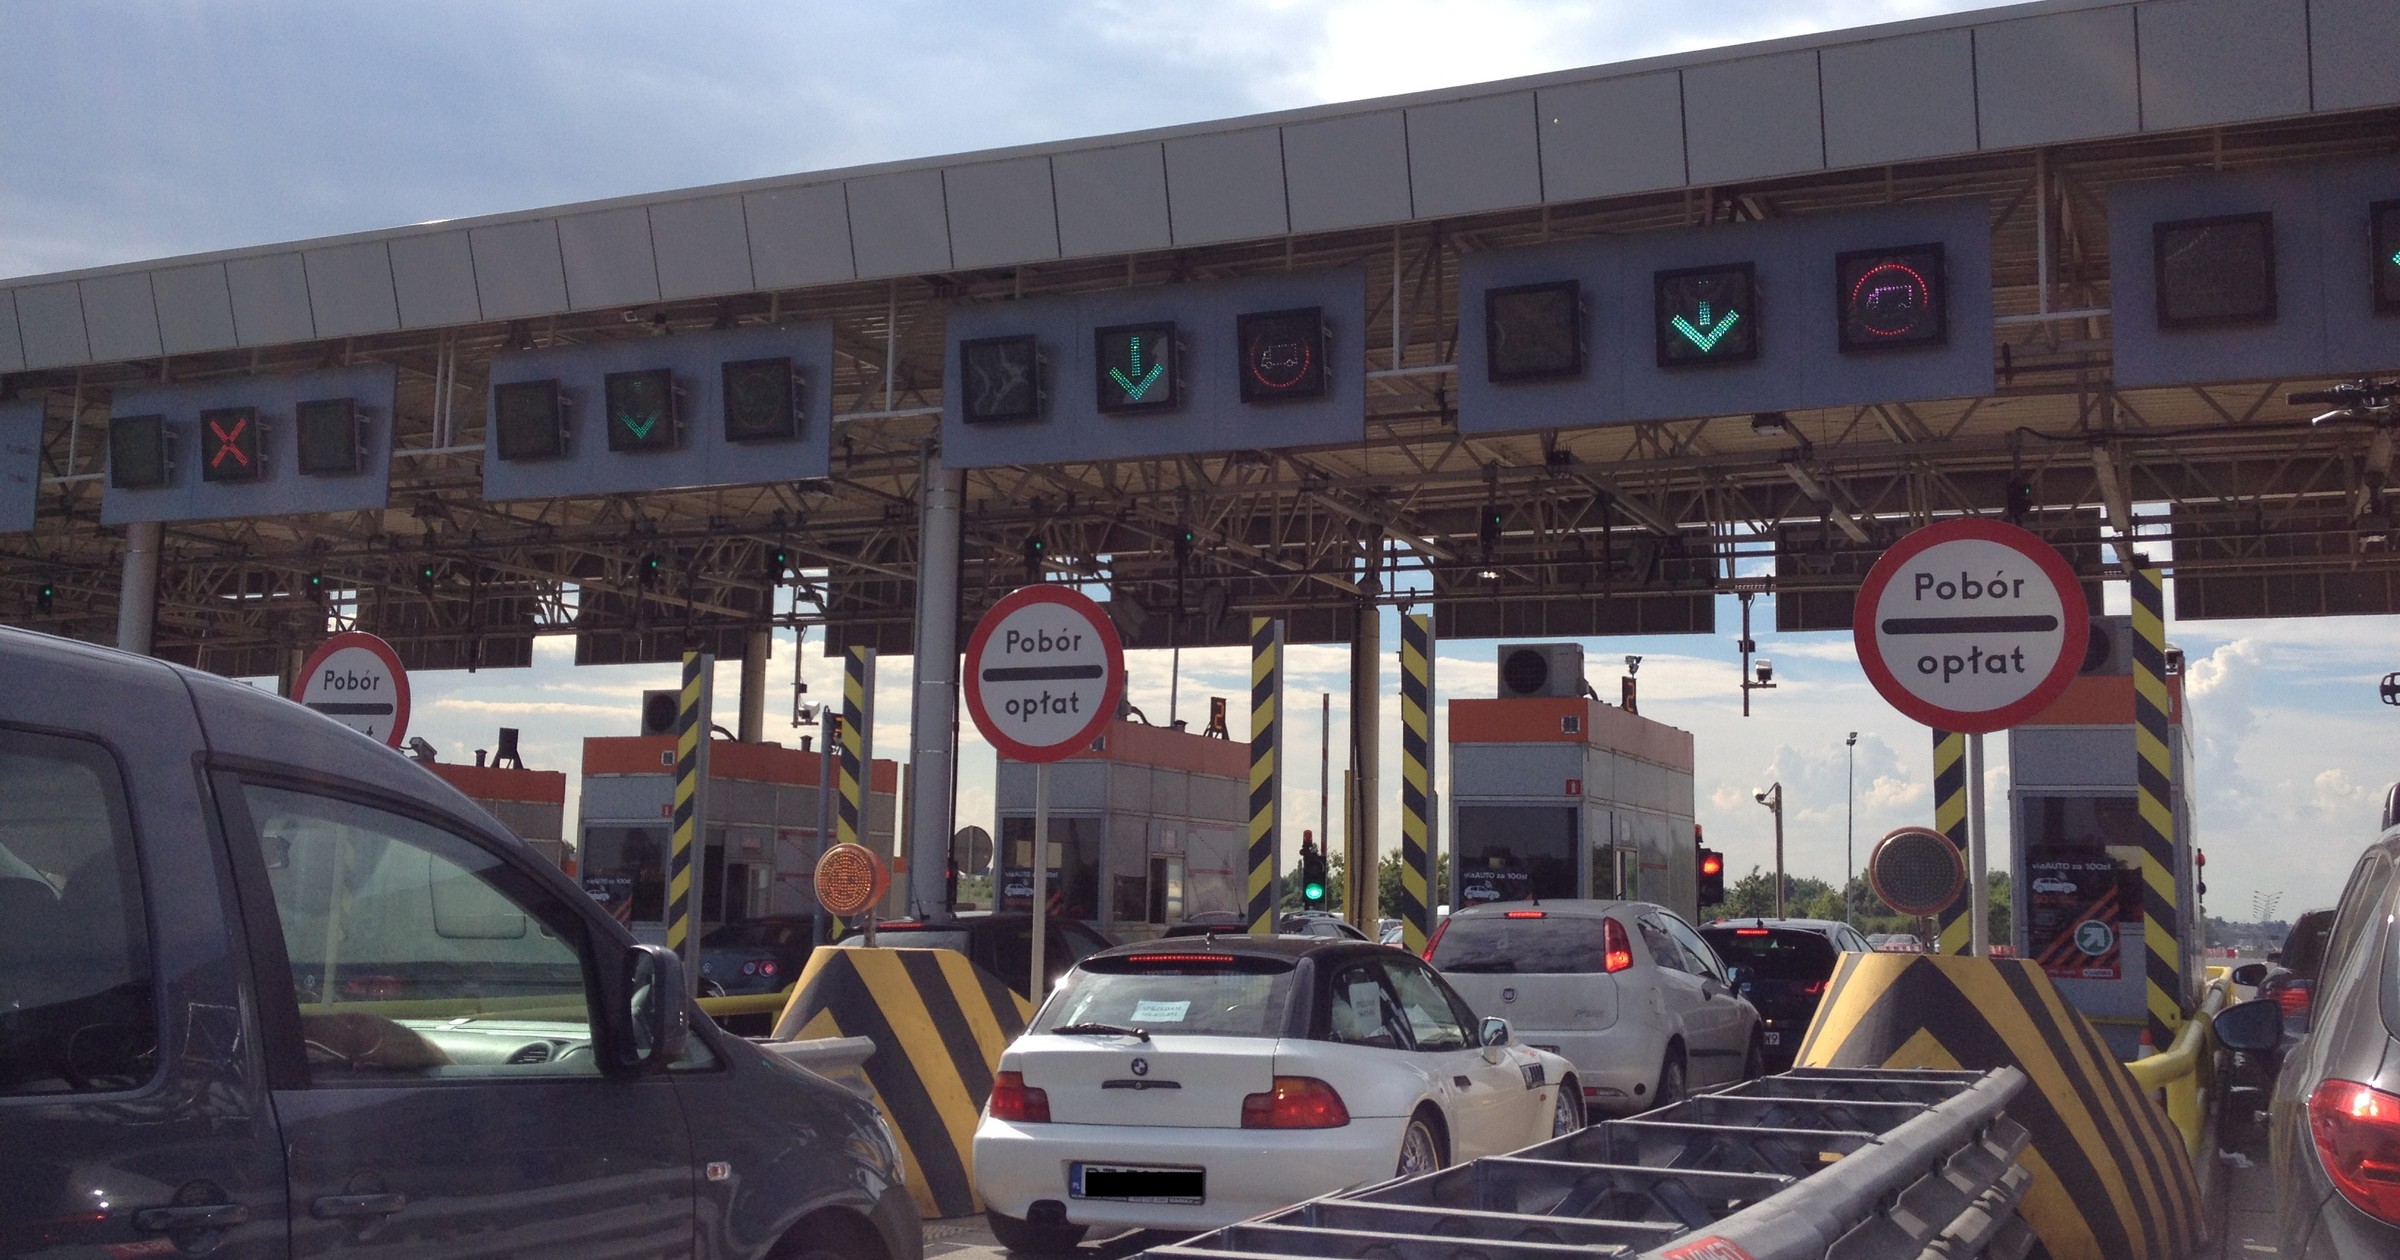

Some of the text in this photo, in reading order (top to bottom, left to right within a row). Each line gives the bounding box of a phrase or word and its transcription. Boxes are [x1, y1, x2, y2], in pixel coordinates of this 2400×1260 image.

[1914, 570, 2025, 601] Pobór
[1006, 628, 1081, 653] Pobór
[1917, 645, 2025, 683] opłat
[323, 670, 380, 691] Pobór
[1005, 690, 1079, 722] opłat
[1214, 701, 1224, 730] 2
